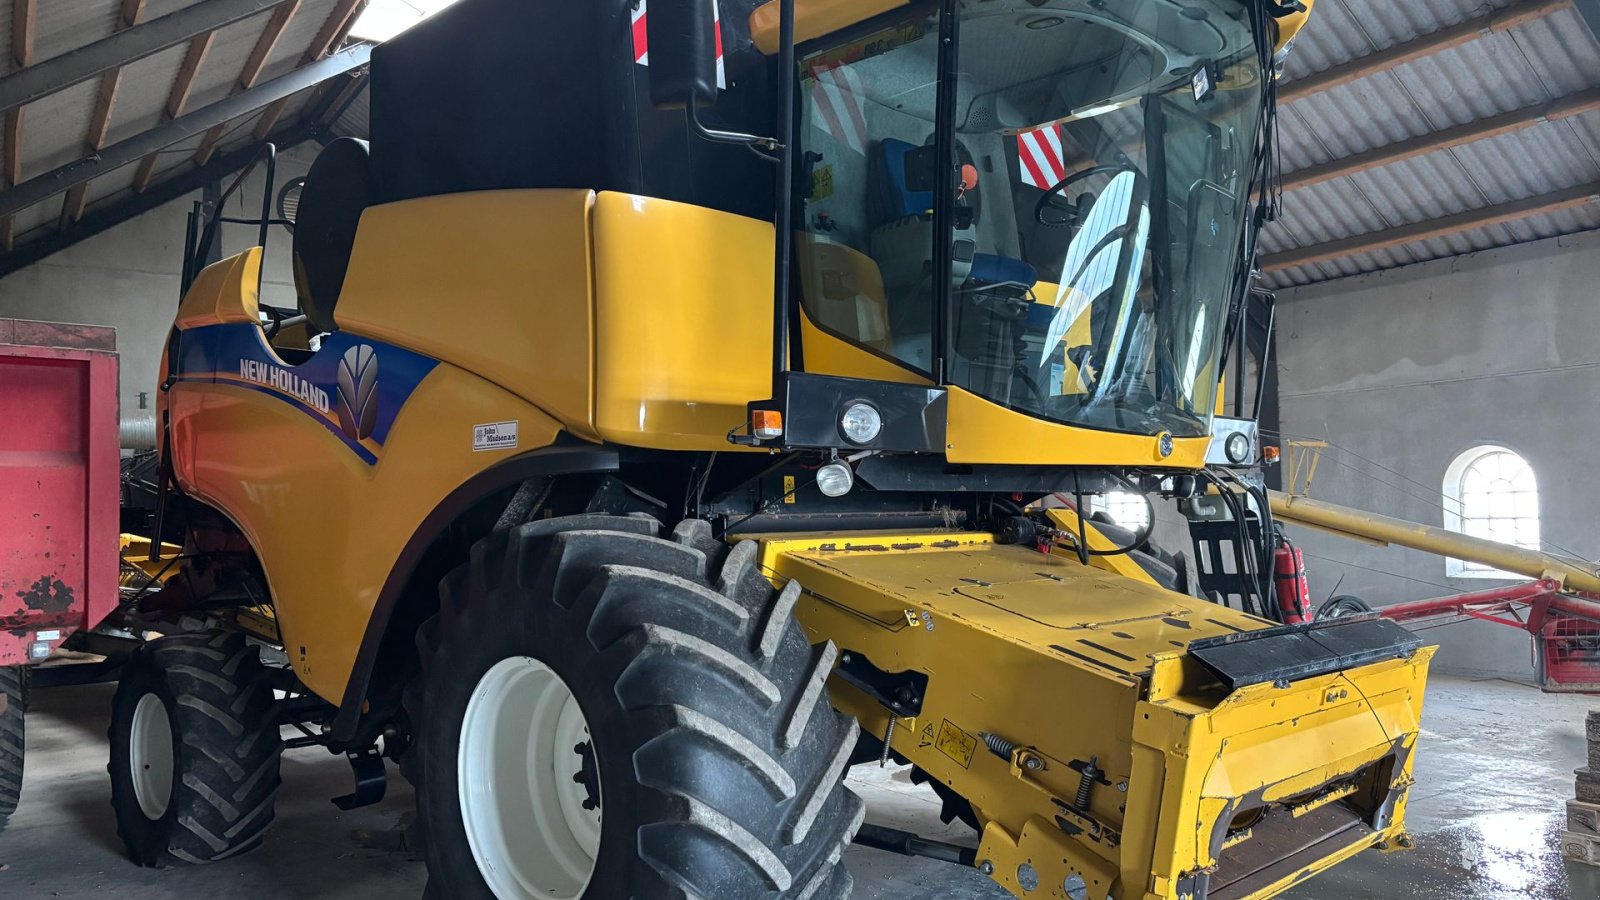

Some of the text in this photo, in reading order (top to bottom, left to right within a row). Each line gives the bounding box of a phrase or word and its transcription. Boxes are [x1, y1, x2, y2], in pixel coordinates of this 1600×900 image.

[240, 358, 330, 414] NEW HOLLAND
[484, 428, 495, 436] John
